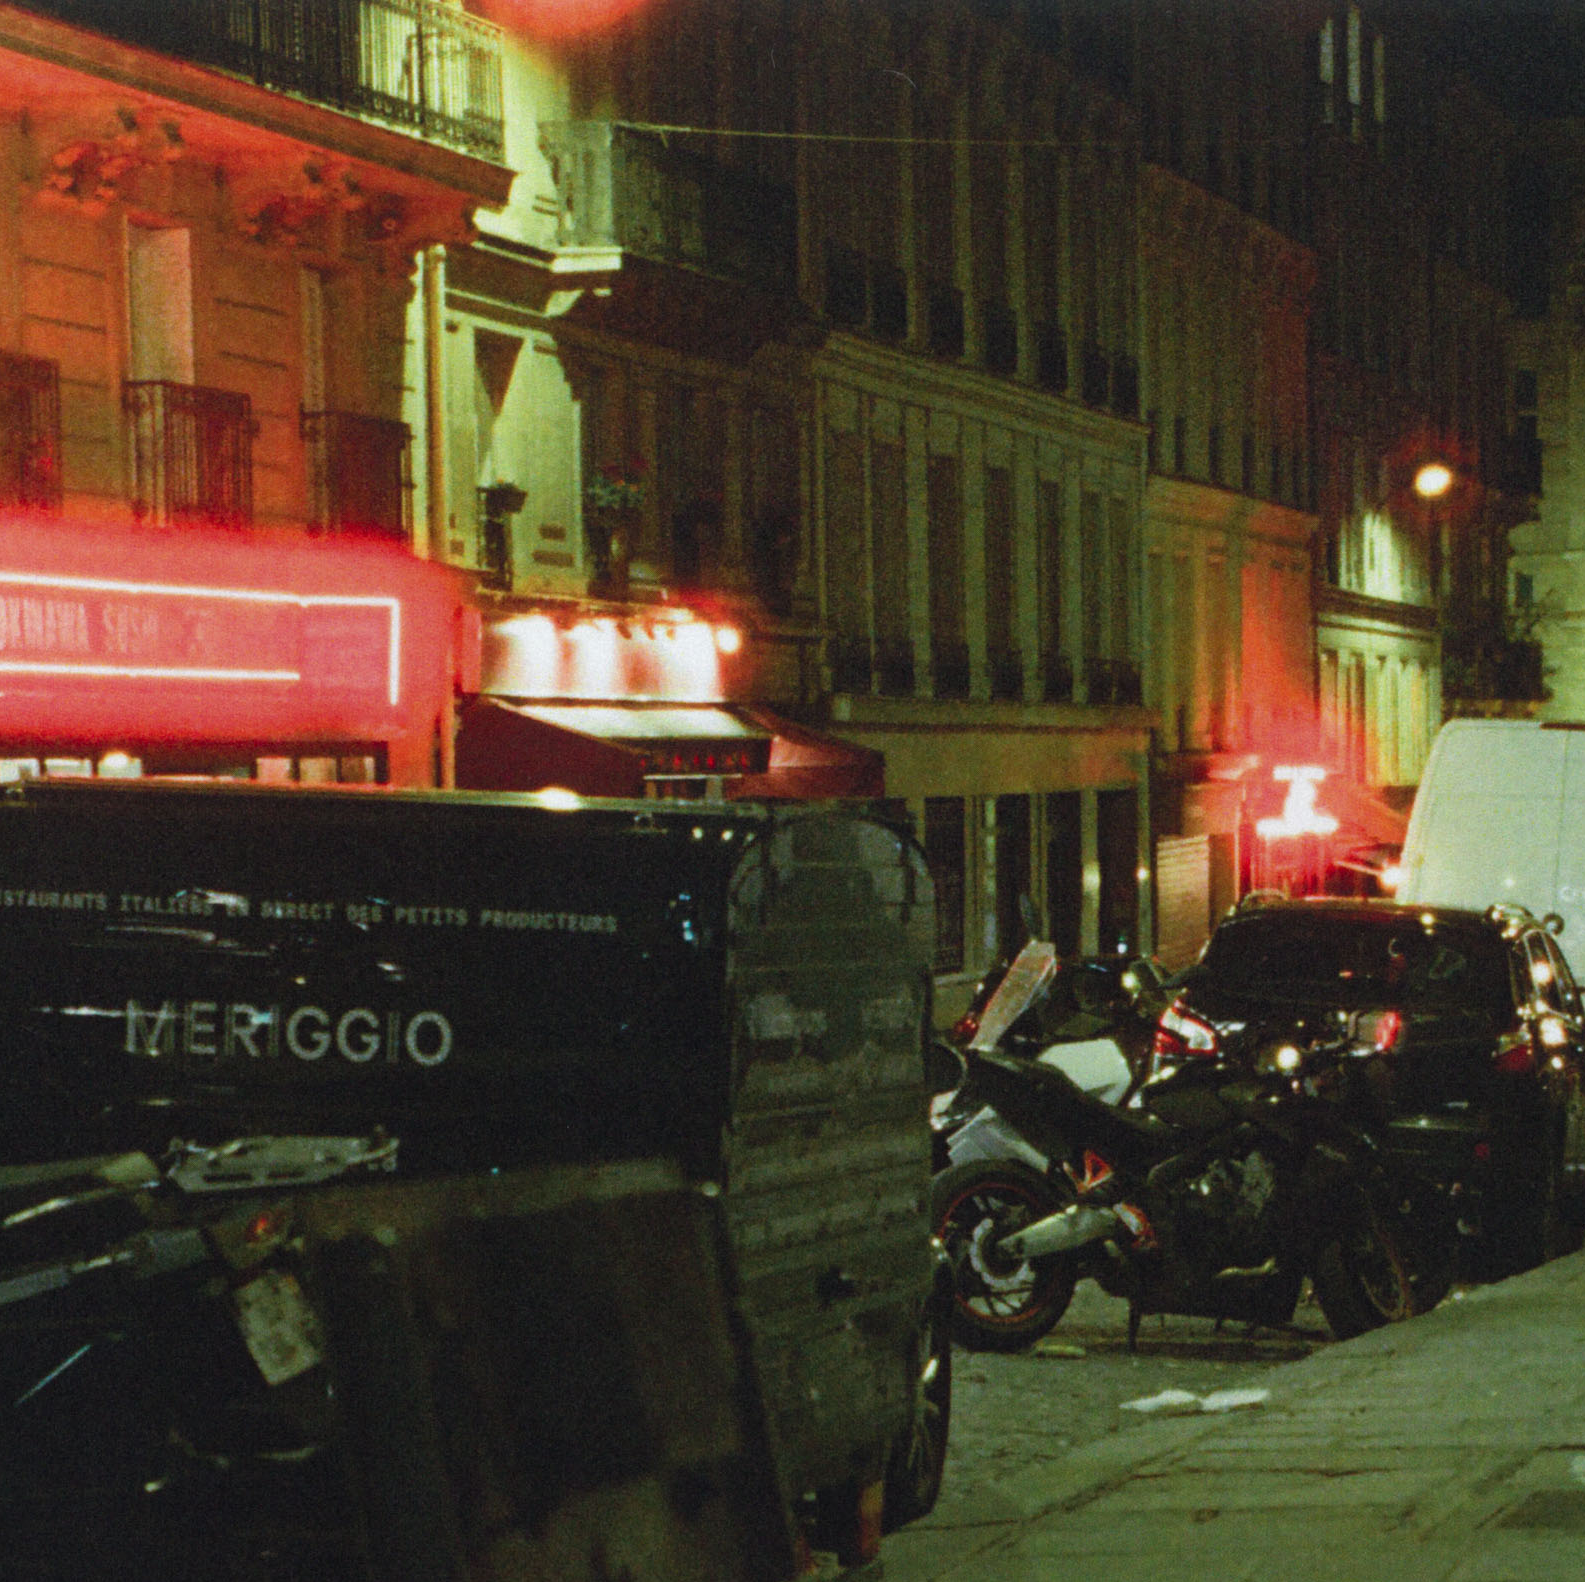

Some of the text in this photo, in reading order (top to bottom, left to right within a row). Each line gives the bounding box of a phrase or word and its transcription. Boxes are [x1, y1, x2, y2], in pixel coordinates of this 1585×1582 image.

[394, 904, 470, 928] PETITS
[480, 908, 620, 935] PRODUCTEURS
[124, 998, 454, 1068] MERIGGIO
